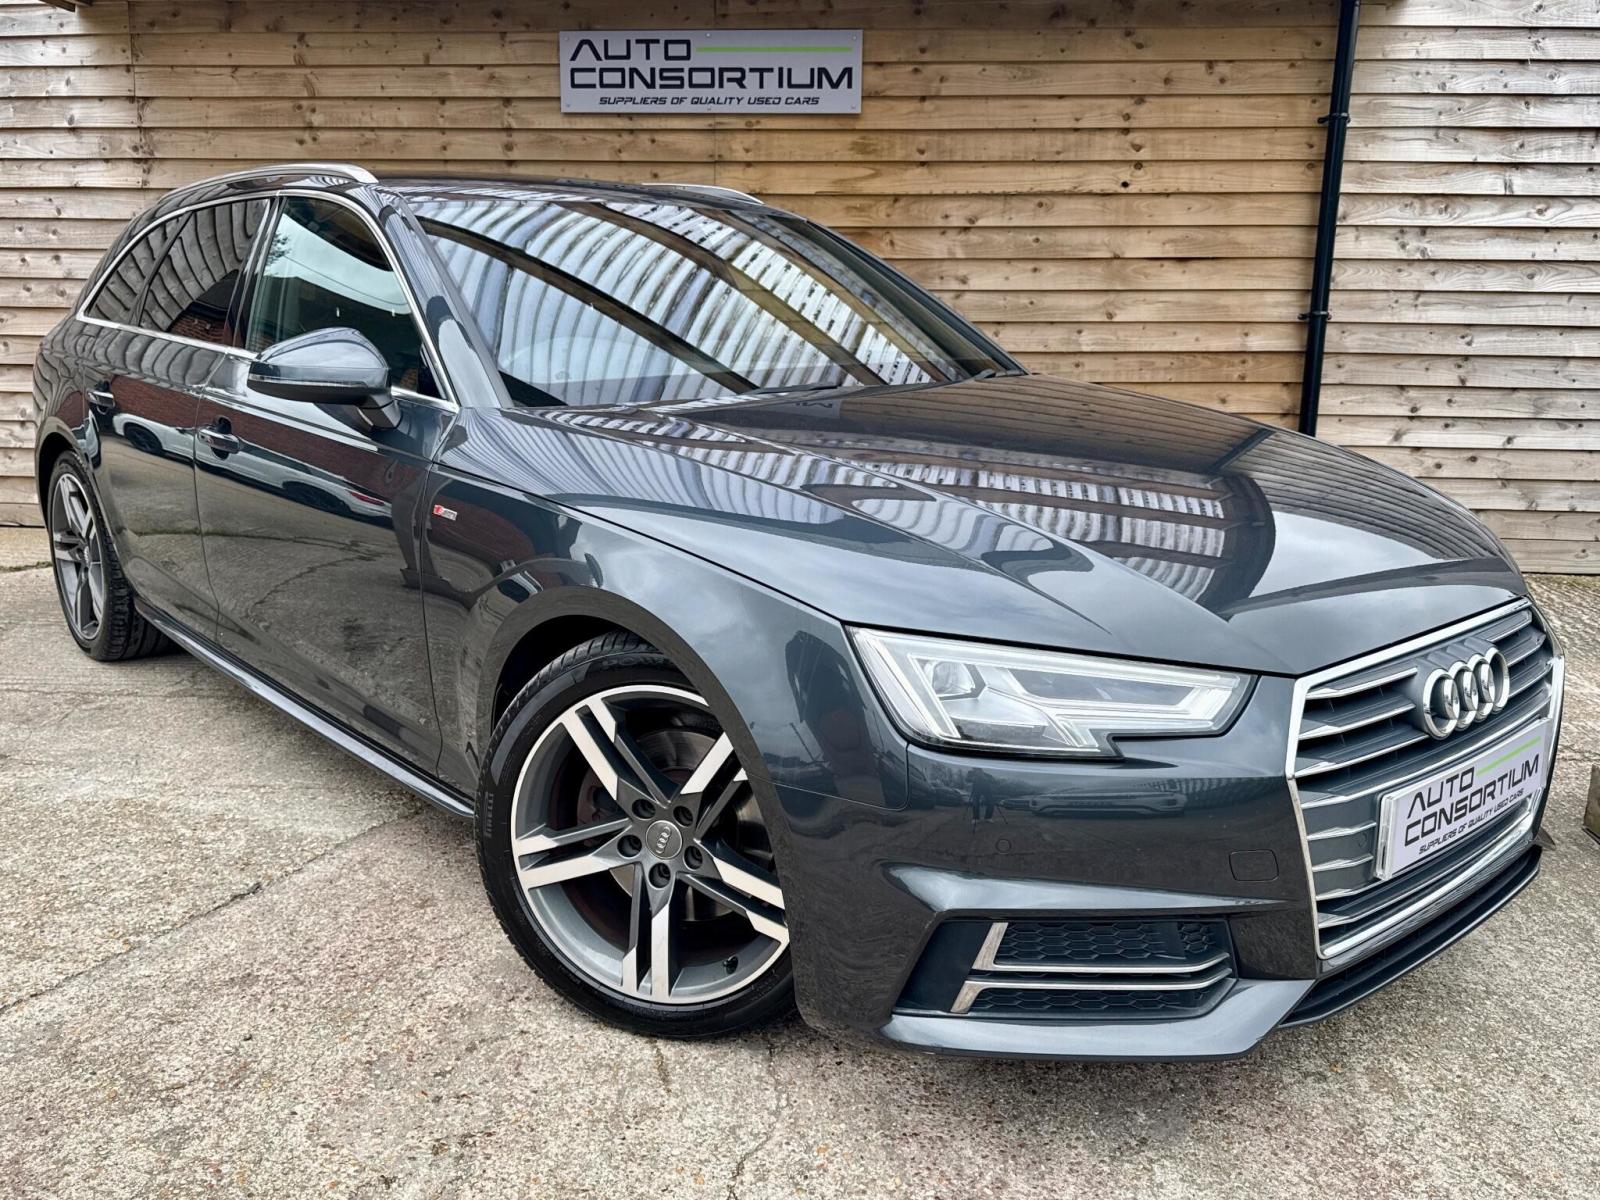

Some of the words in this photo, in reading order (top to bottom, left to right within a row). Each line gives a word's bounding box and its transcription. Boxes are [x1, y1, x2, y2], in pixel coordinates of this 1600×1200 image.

[569, 38, 692, 61] AUTO
[569, 66, 853, 89] CONSORTIUM
[599, 96, 668, 105] SUPPLIERS
[670, 96, 687, 105] OF
[690, 96, 744, 105] QUALITY
[747, 96, 782, 105] USED
[784, 96, 820, 105] CARS
[1404, 754, 1540, 847] CONSORTIUM
[1407, 766, 1475, 819] AUTO
[1418, 828, 1458, 855] SUPPLIERS
[1468, 808, 1494, 829] QUALITY
[1509, 787, 1525, 803] CARS
